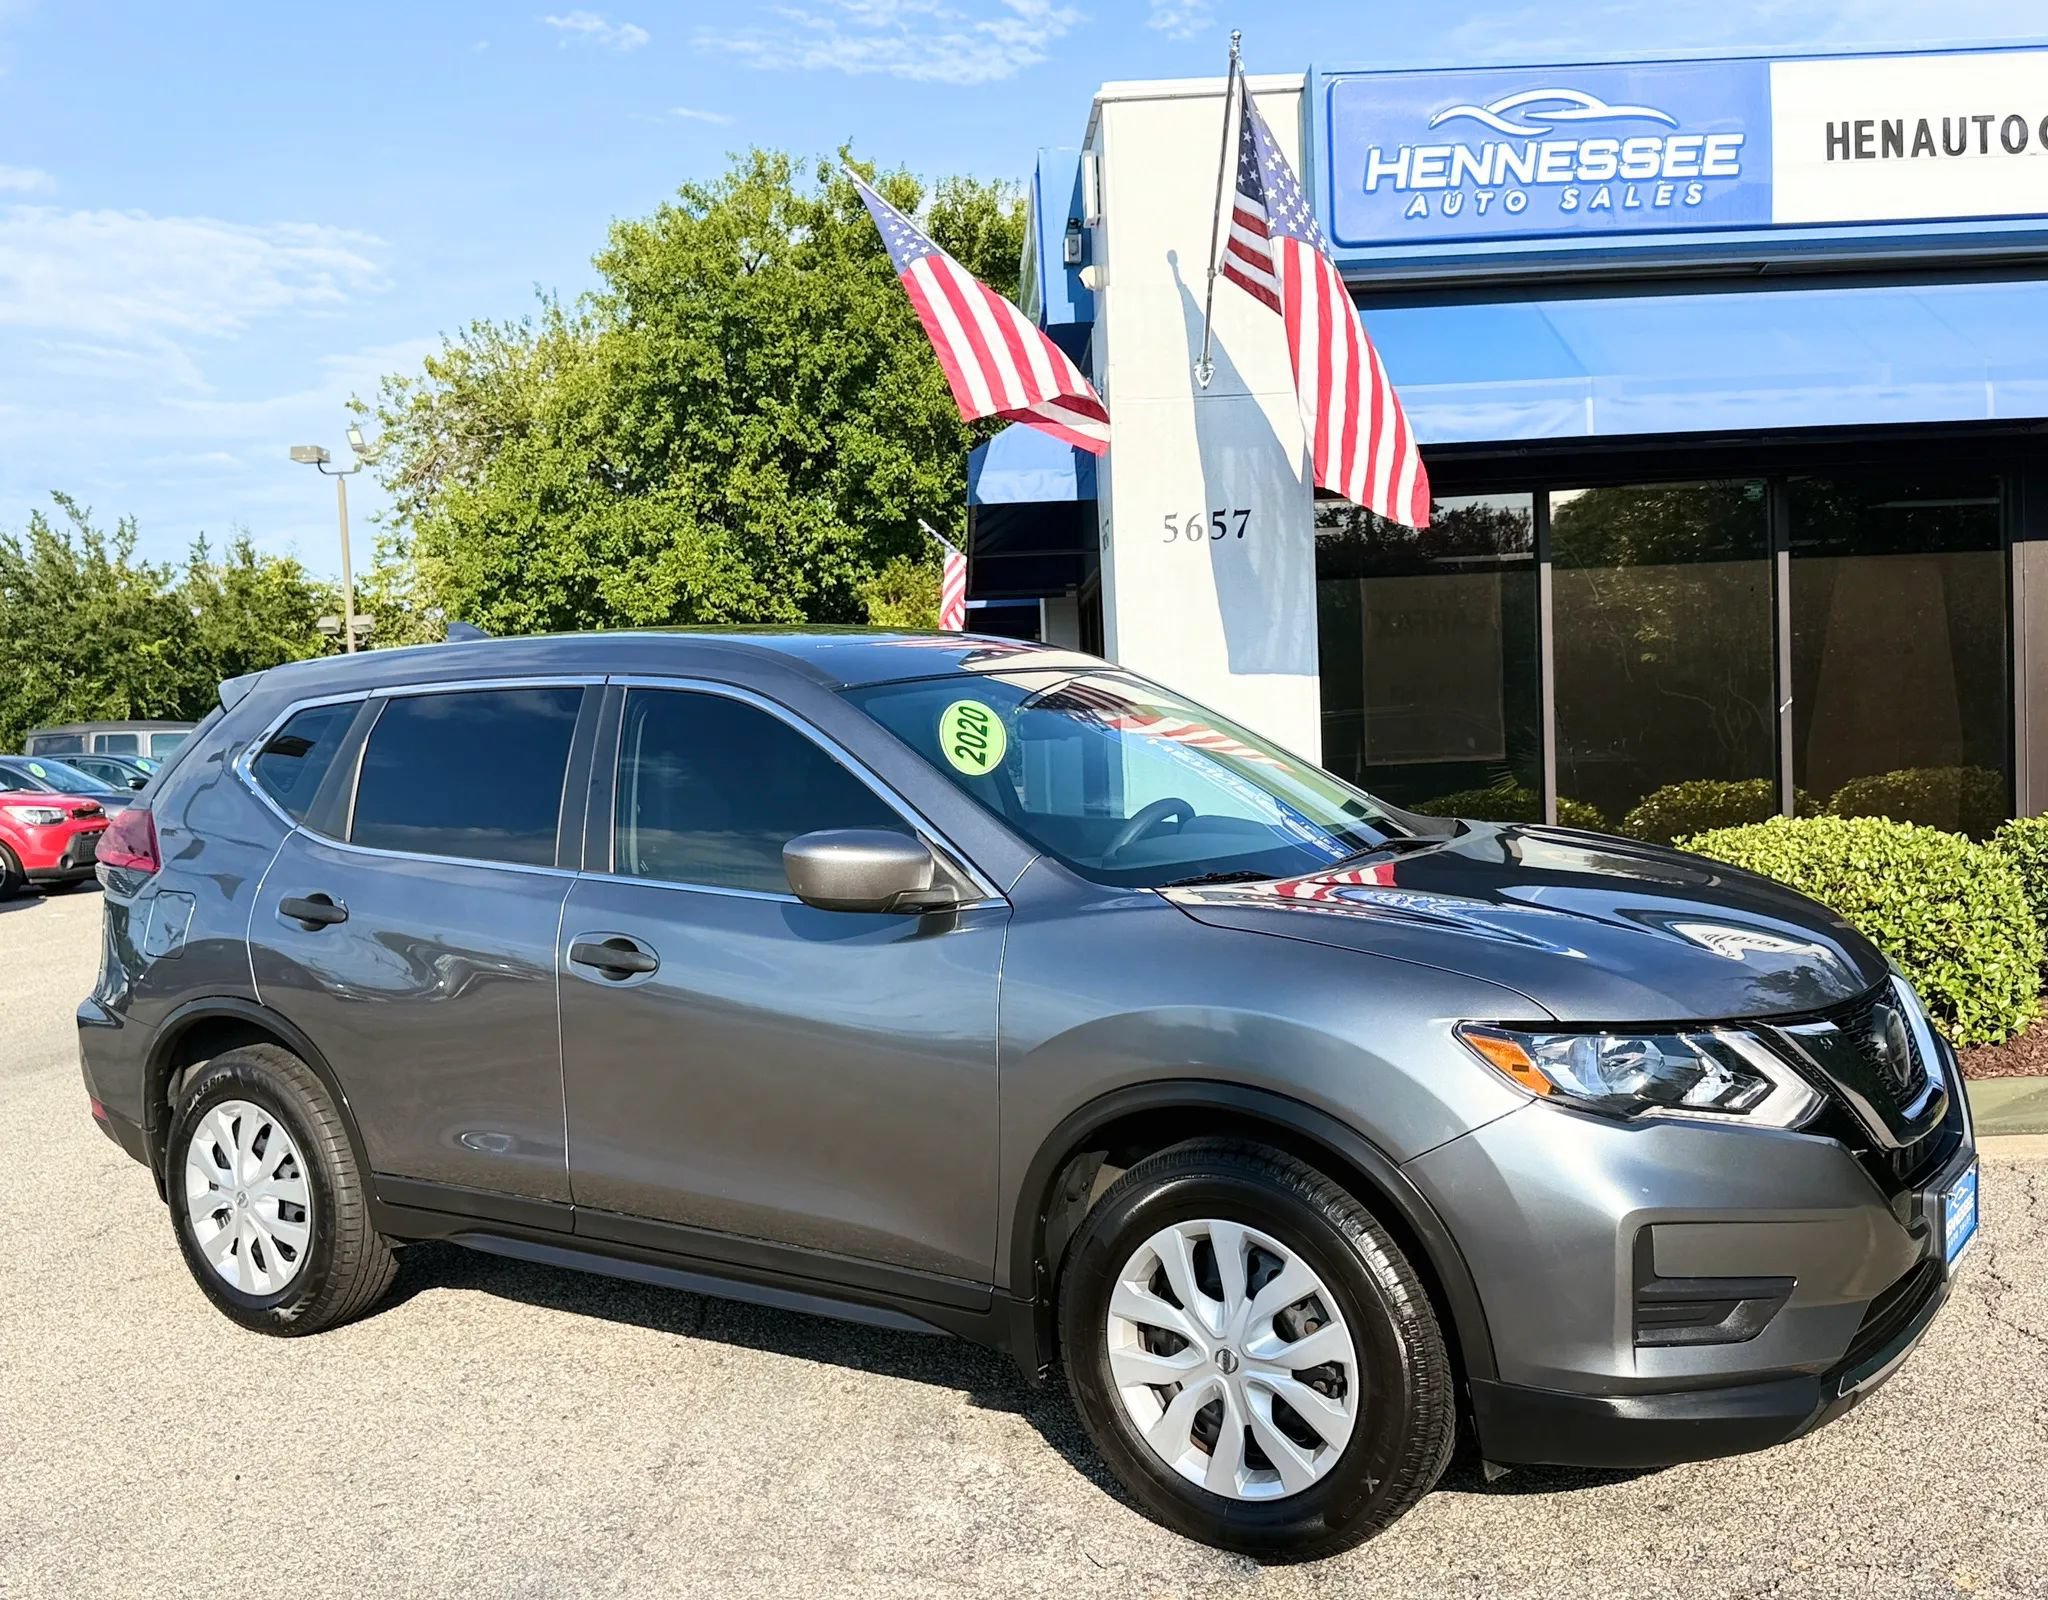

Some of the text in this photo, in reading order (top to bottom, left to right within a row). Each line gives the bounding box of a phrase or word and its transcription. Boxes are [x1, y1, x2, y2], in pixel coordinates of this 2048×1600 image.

[1365, 133, 1744, 191] HENNESSEE
[1406, 181, 1704, 218] AUTO SALES
[1162, 508, 1252, 543] 5657
[954, 706, 988, 768] 2020
